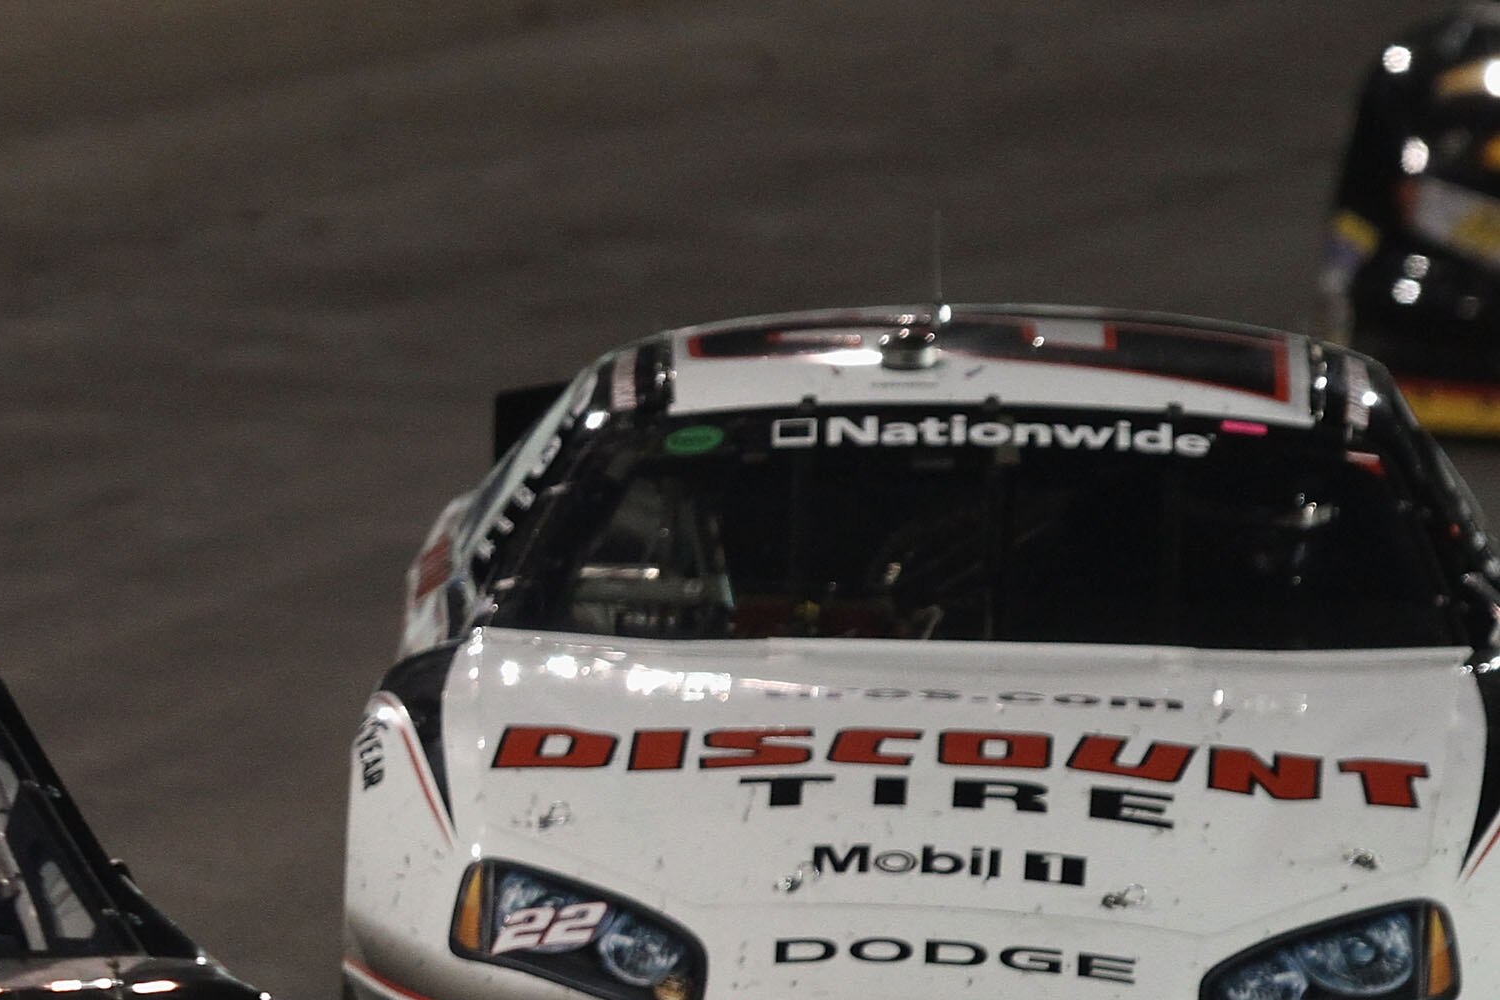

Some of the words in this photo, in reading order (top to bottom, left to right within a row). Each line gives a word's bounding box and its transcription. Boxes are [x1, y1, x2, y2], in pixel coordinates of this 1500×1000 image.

[825, 414, 1211, 457] Nationwide
[490, 725, 1429, 809] DISCOUNT
[739, 775, 1176, 829] TIRE
[812, 844, 1002, 883] Mobil
[490, 901, 608, 956] 22
[773, 936, 1137, 986] DODGE
